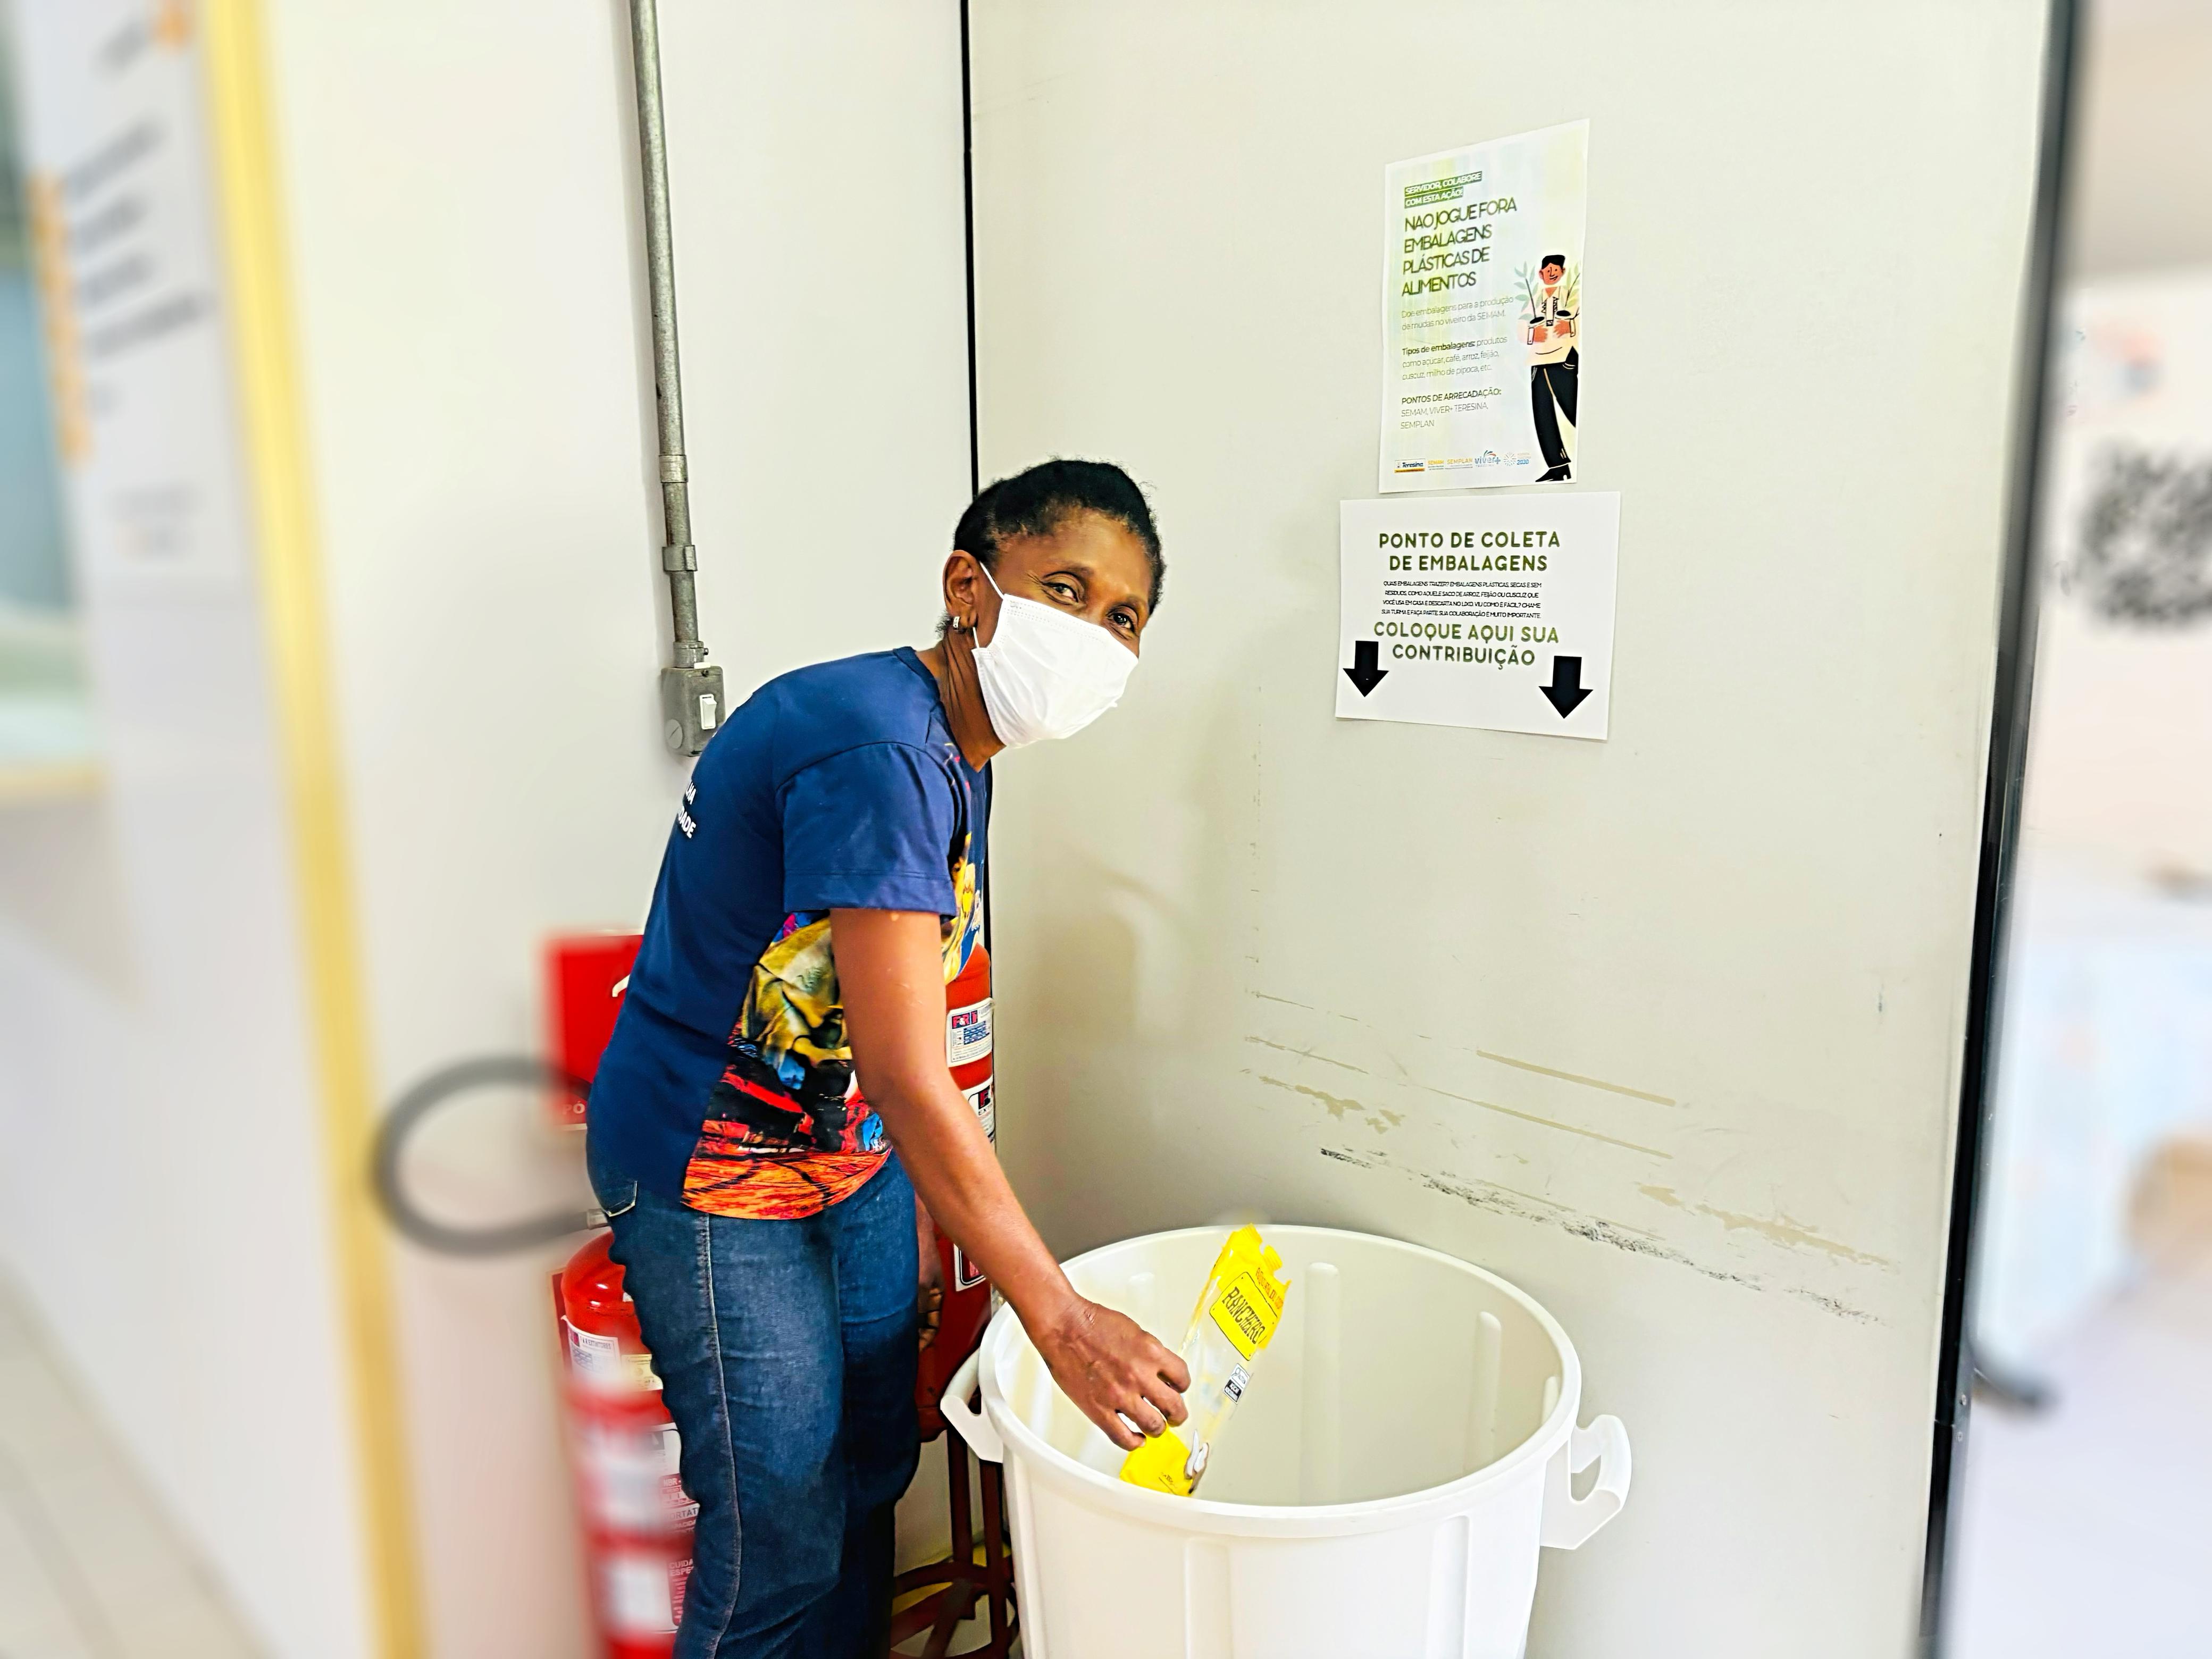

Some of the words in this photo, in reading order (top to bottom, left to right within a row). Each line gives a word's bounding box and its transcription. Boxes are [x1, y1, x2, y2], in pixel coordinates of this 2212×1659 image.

[1443, 172, 1481, 187] COLABORE
[1405, 198, 1422, 206] COM
[1423, 194, 1440, 203] ESTA
[1434, 204, 1477, 230] JOGUE
[1479, 197, 1517, 217] FORA
[1404, 224, 1492, 253] EMBALAGENS
[1403, 250, 1470, 275] PLÁSTICAS
[1471, 247, 1490, 264] DE
[1402, 271, 1477, 296] ALIMENTOS
[1415, 304, 1456, 316] embalagens
[1458, 302, 1472, 312] para
[1480, 296, 1513, 308] produção
[1412, 320, 1434, 329] mudas
[1445, 316, 1467, 325] viveiro
[1402, 348, 1420, 357] Tipos
[1477, 336, 1507, 347] produtos
[1426, 368, 1445, 378] milho
[1402, 395, 1431, 405] PONTOS
[1443, 387, 1502, 401] ARRECADAÇÃO:
[1401, 419, 1435, 429] SEMPLAN
[1379, 532, 1444, 549] PONTO
[1451, 532, 1474, 548] DE
[1481, 531, 1560, 548] COLETA
[1389, 556, 1412, 571] DE
[1419, 555, 1548, 572] EMBALAGENS
[1374, 622, 1462, 642] COLOQUE
[1468, 625, 1514, 644] AQUI
[1521, 626, 1559, 643] SUA
[1393, 644, 1535, 670] CONTRIBUIÇÃO
[1222, 1286, 1266, 1344] RANCHERO
